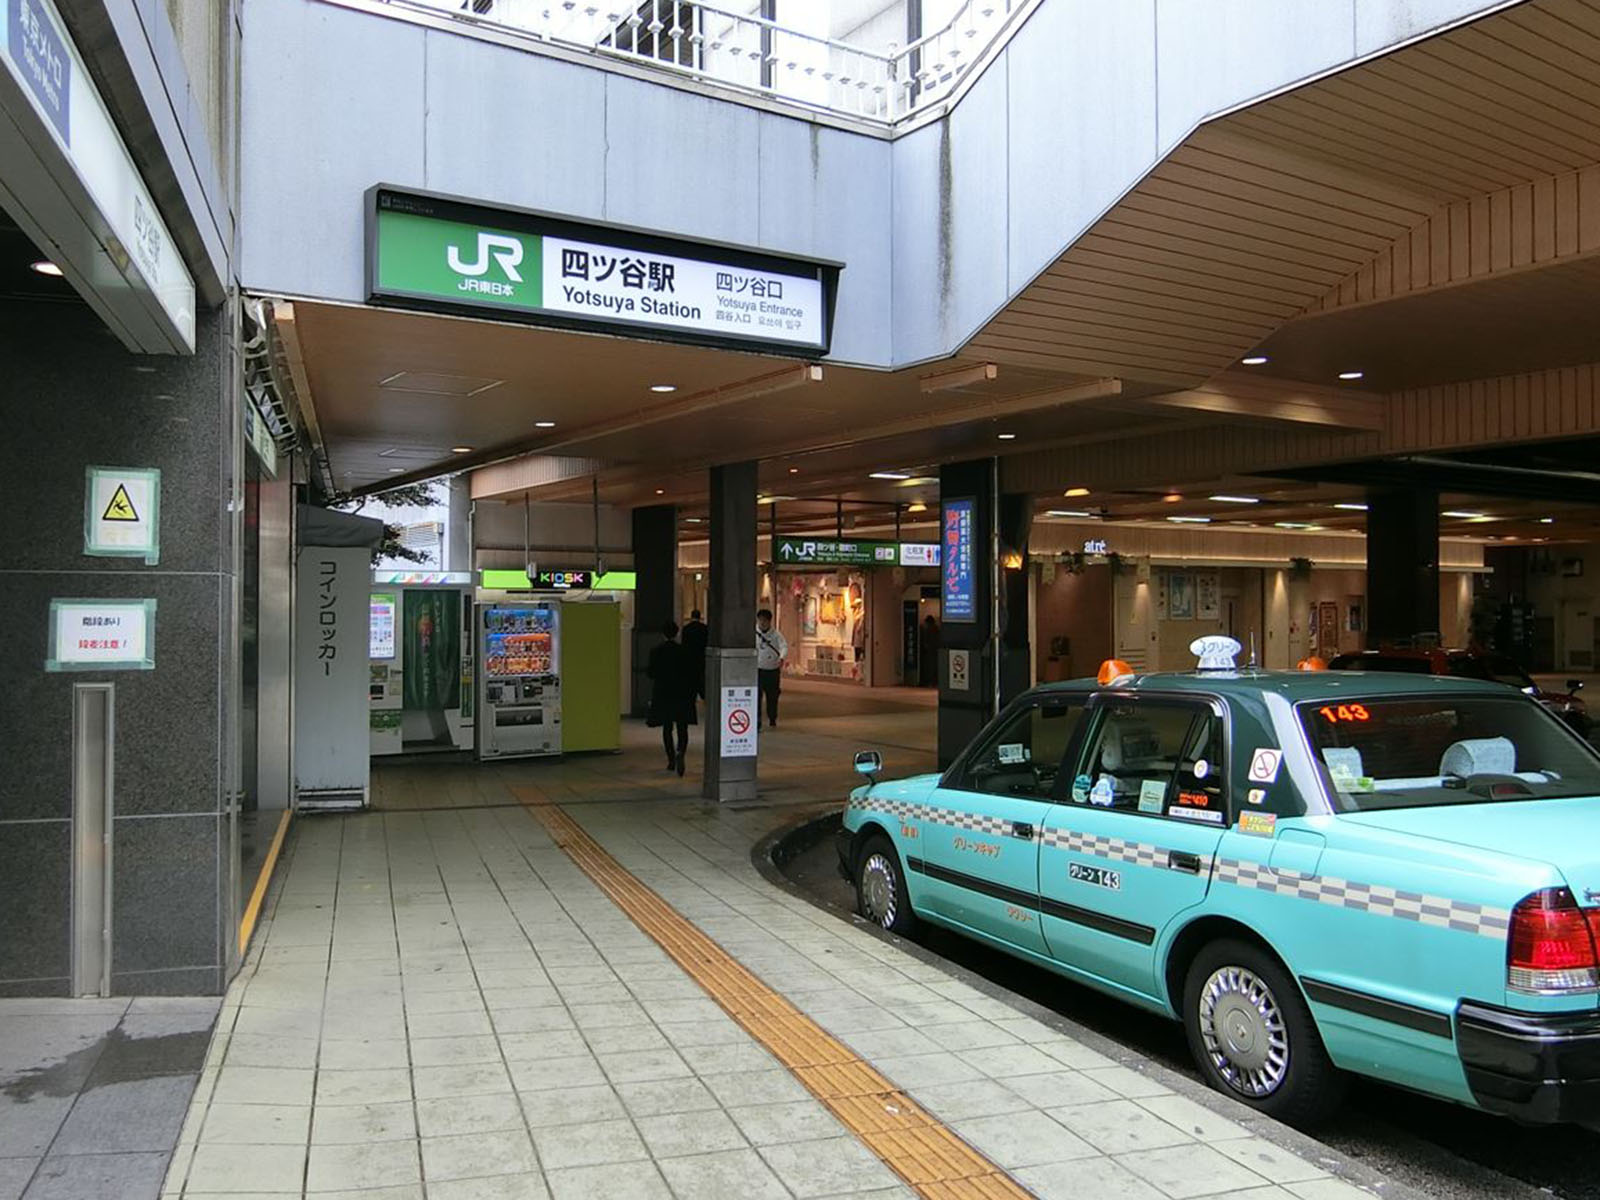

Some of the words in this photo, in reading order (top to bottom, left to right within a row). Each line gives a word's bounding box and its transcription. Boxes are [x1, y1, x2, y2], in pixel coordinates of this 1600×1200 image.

[447, 232, 523, 283] JR
[562, 248, 675, 293] 四ツ谷駅
[458, 278, 514, 297] JR東日本
[716, 272, 783, 300] 四ツ谷口
[563, 285, 635, 313] Yotsuya
[641, 296, 701, 319] Station
[717, 294, 757, 312] Yotsuya
[759, 301, 804, 318] Entrance
[796, 542, 816, 557] JR
[540, 572, 584, 583] KIOSK
[319, 561, 337, 676] コインロッカー
[1320, 704, 1369, 722] 143
[1070, 865, 1095, 881] グリーン
[1098, 870, 1119, 889] 143
